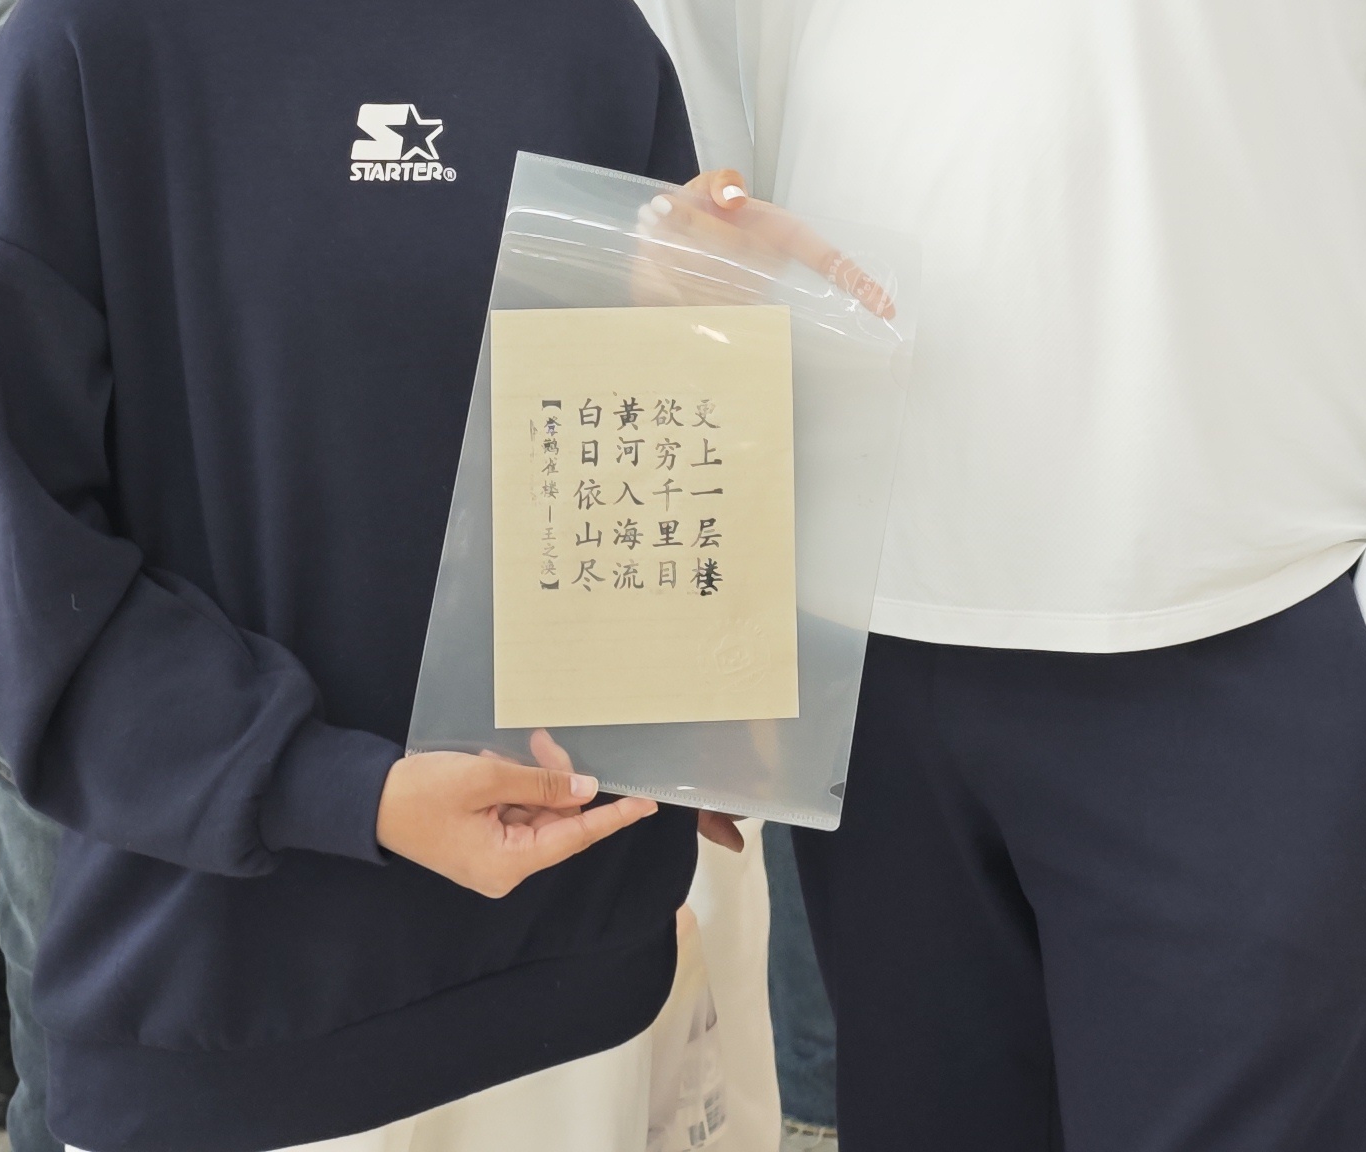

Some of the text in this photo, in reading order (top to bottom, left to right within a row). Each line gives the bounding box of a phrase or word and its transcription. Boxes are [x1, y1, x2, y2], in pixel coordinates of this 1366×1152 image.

[571, 398, 607, 592] 白日依山尽
[612, 397, 645, 590] 黄河入海流
[651, 399, 684, 589] 欲穷千里目
